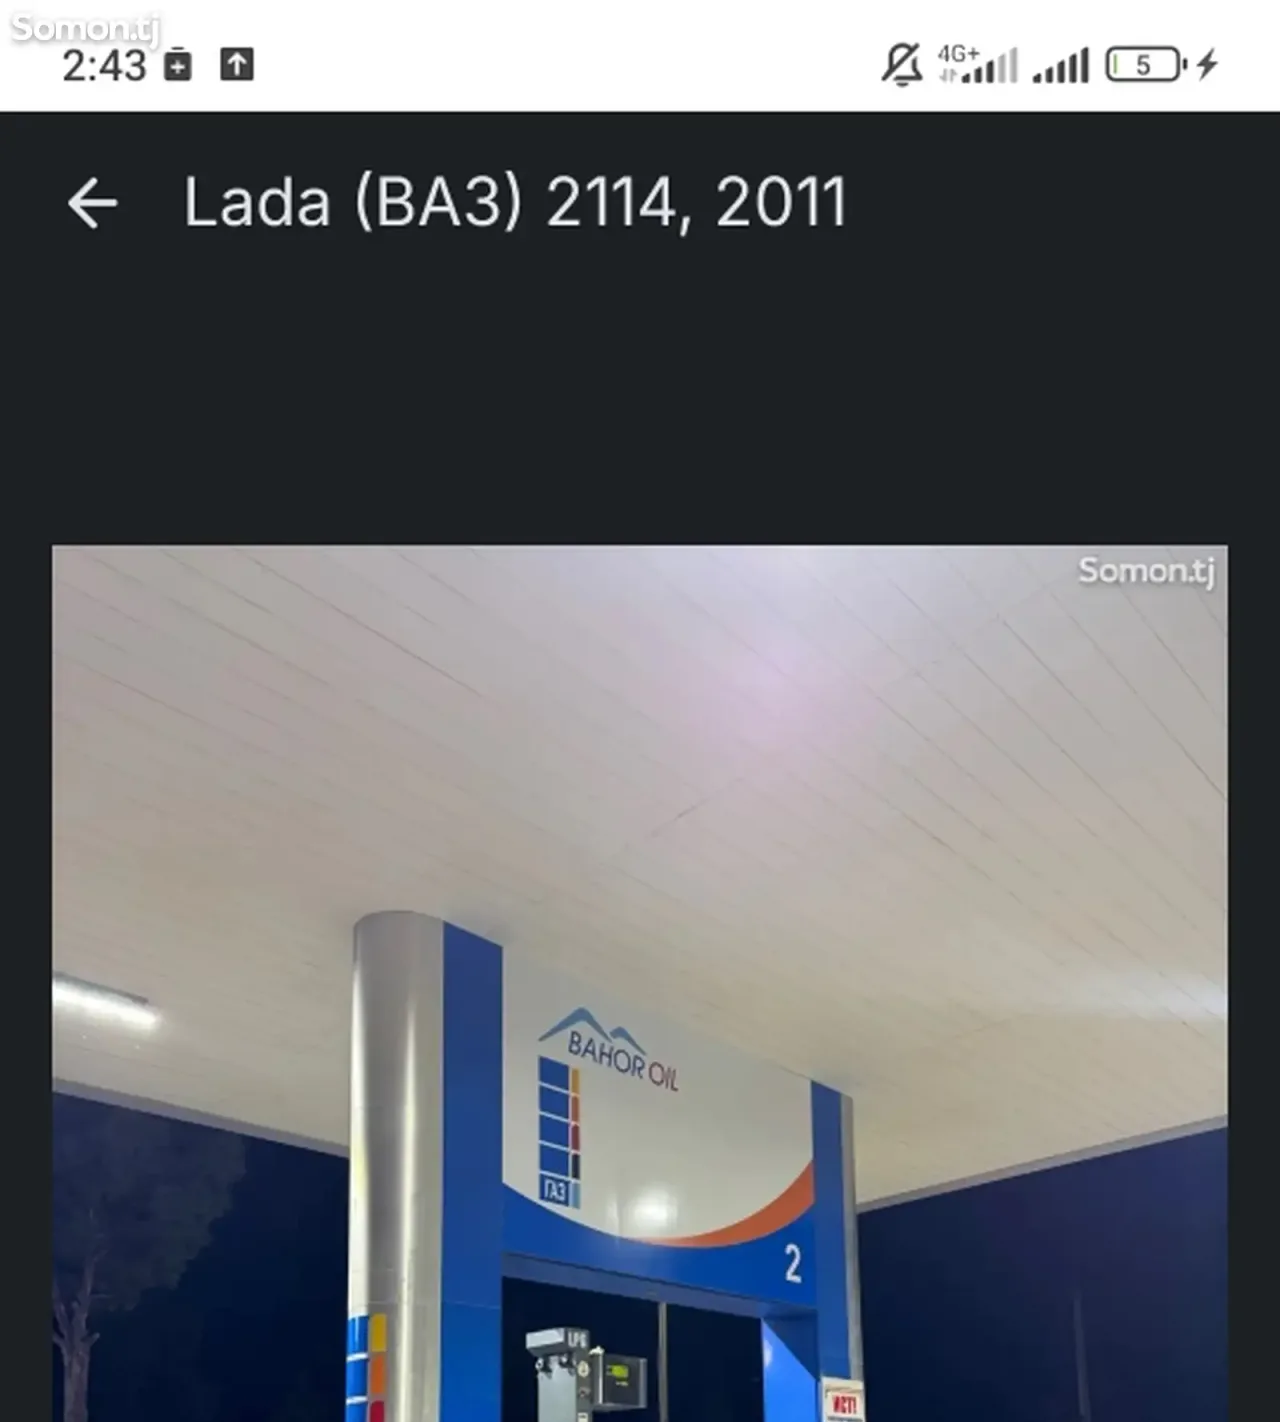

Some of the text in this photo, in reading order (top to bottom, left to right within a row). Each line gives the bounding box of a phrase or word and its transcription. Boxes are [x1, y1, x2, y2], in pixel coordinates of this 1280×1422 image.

[63, 48, 146, 81] 2:43
[938, 44, 980, 62] 4G+
[1137, 55, 1150, 75] 5
[186, 175, 329, 227] Lada
[547, 175, 691, 237] 2114,
[717, 175, 845, 227] 2011
[568, 1030, 679, 1092] BAHOR OIL
[544, 1179, 567, 1201] ГАЗ
[785, 1243, 802, 1284] 2
